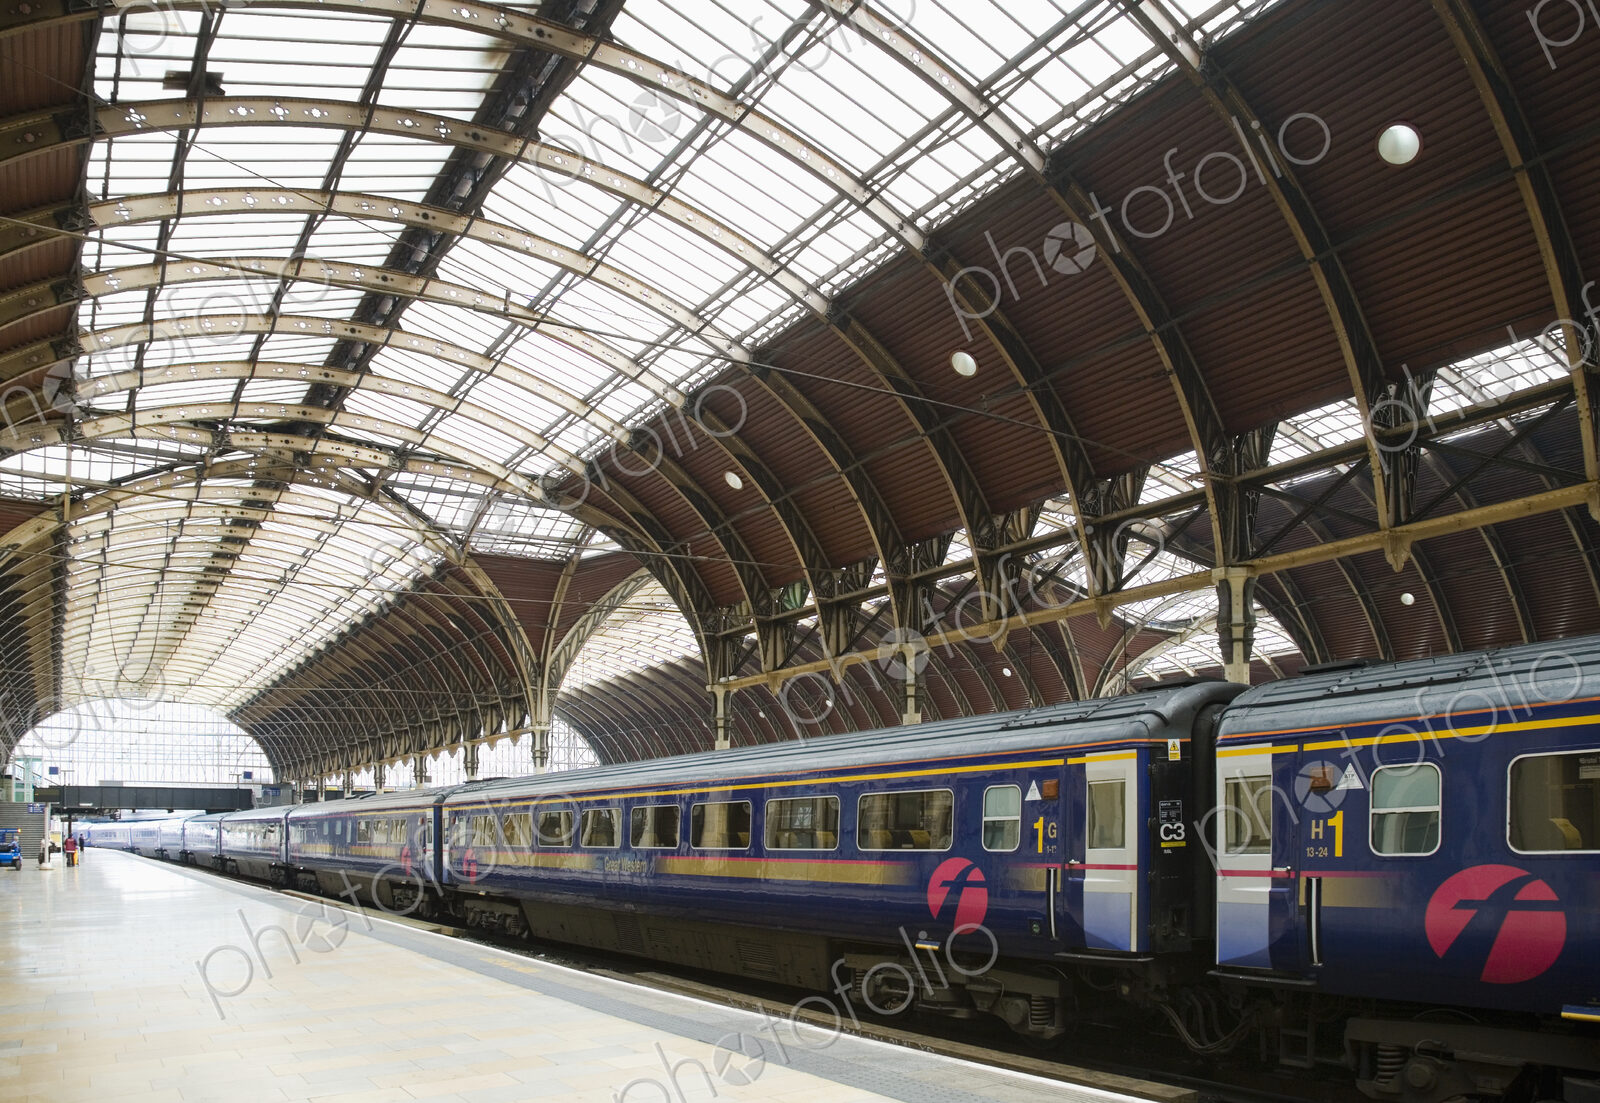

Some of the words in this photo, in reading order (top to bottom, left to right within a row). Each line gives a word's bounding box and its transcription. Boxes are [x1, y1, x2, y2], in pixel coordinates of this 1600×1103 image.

[1033, 816, 1044, 854] 1
[1047, 822, 1057, 839] G
[1160, 823, 1186, 841] C3
[1311, 819, 1324, 840] H
[1327, 810, 1344, 857] 1
[1306, 846, 1328, 858] 13-24
[604, 856, 620, 872] Great
[621, 857, 647, 873] Western
